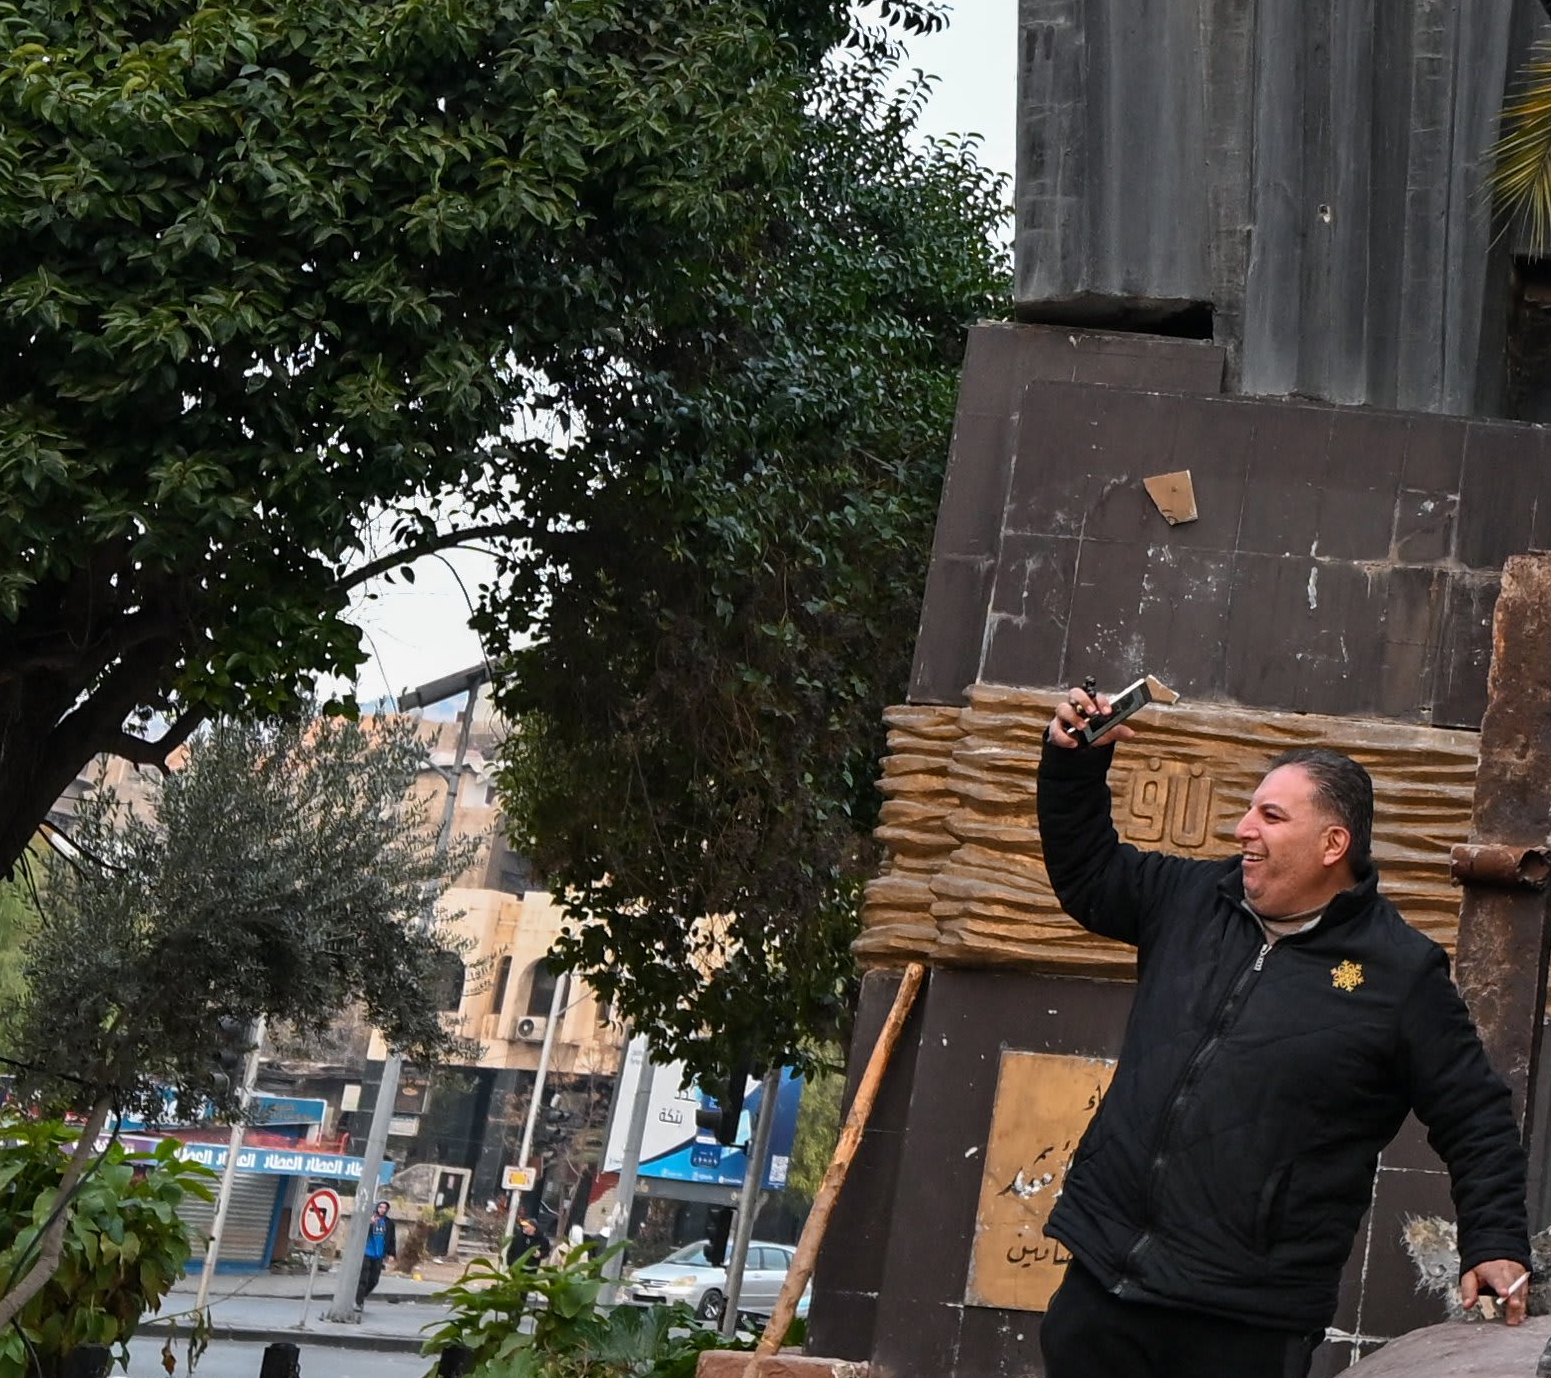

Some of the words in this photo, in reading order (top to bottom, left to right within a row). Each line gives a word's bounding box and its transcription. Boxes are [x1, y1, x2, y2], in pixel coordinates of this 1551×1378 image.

[216, 1150, 256, 1169] العار
[263, 1153, 303, 1171] العطار
[304, 1156, 343, 1175] العطار
